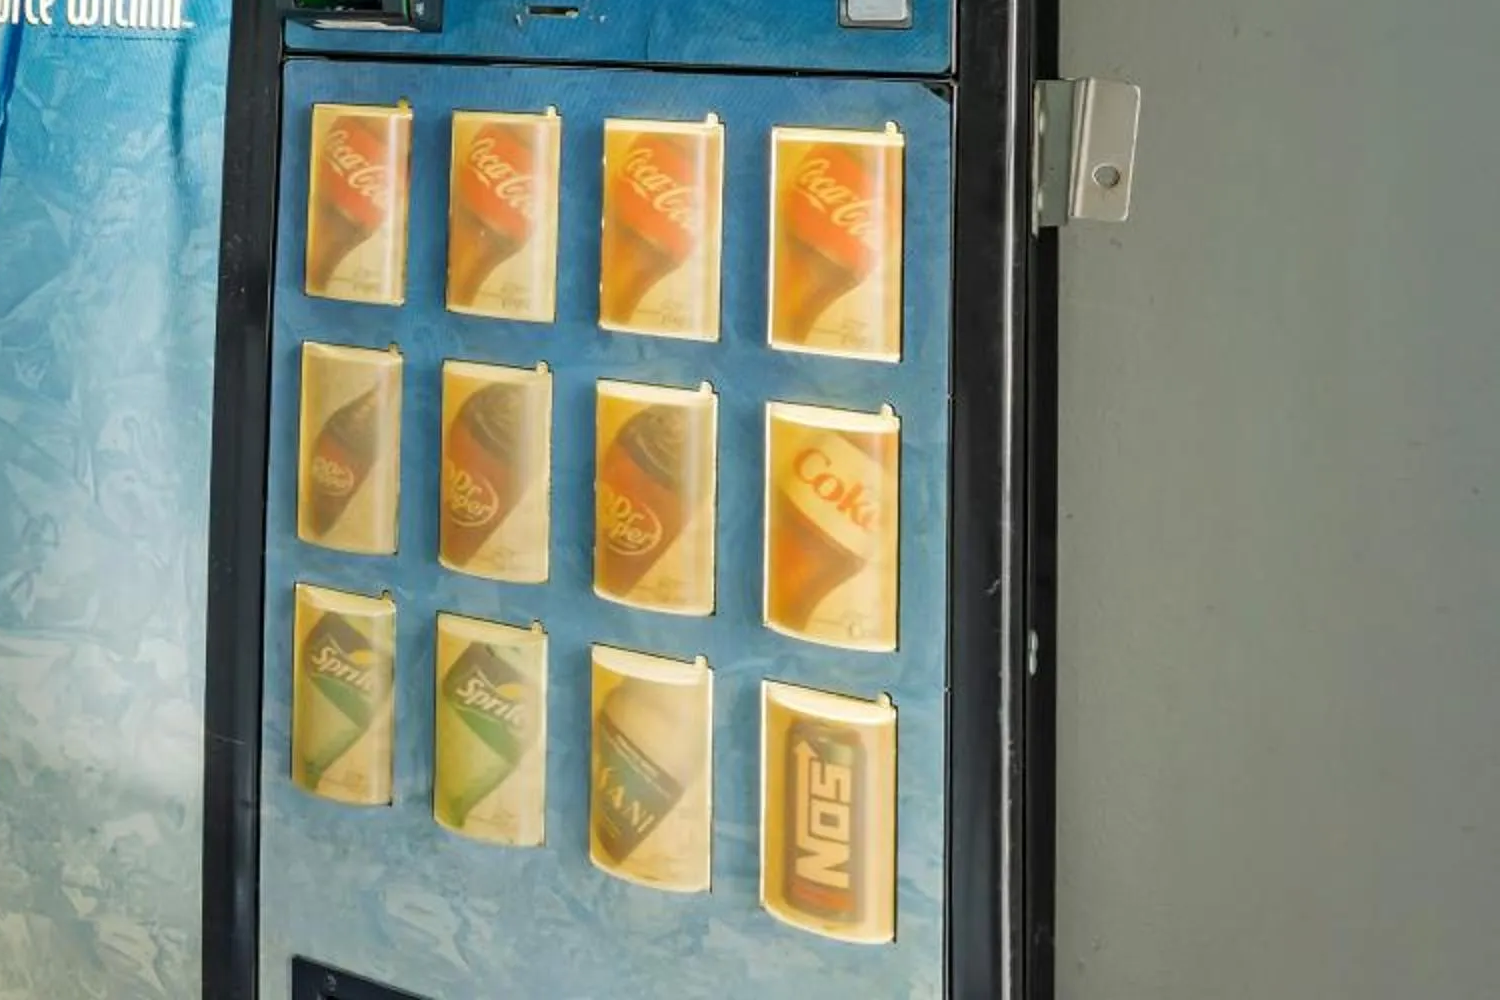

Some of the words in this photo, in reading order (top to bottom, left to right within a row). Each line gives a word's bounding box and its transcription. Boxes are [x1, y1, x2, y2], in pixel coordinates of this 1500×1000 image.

[311, 646, 377, 693] Sprit
[457, 679, 528, 728] Sprit
[794, 744, 852, 890] NOS
